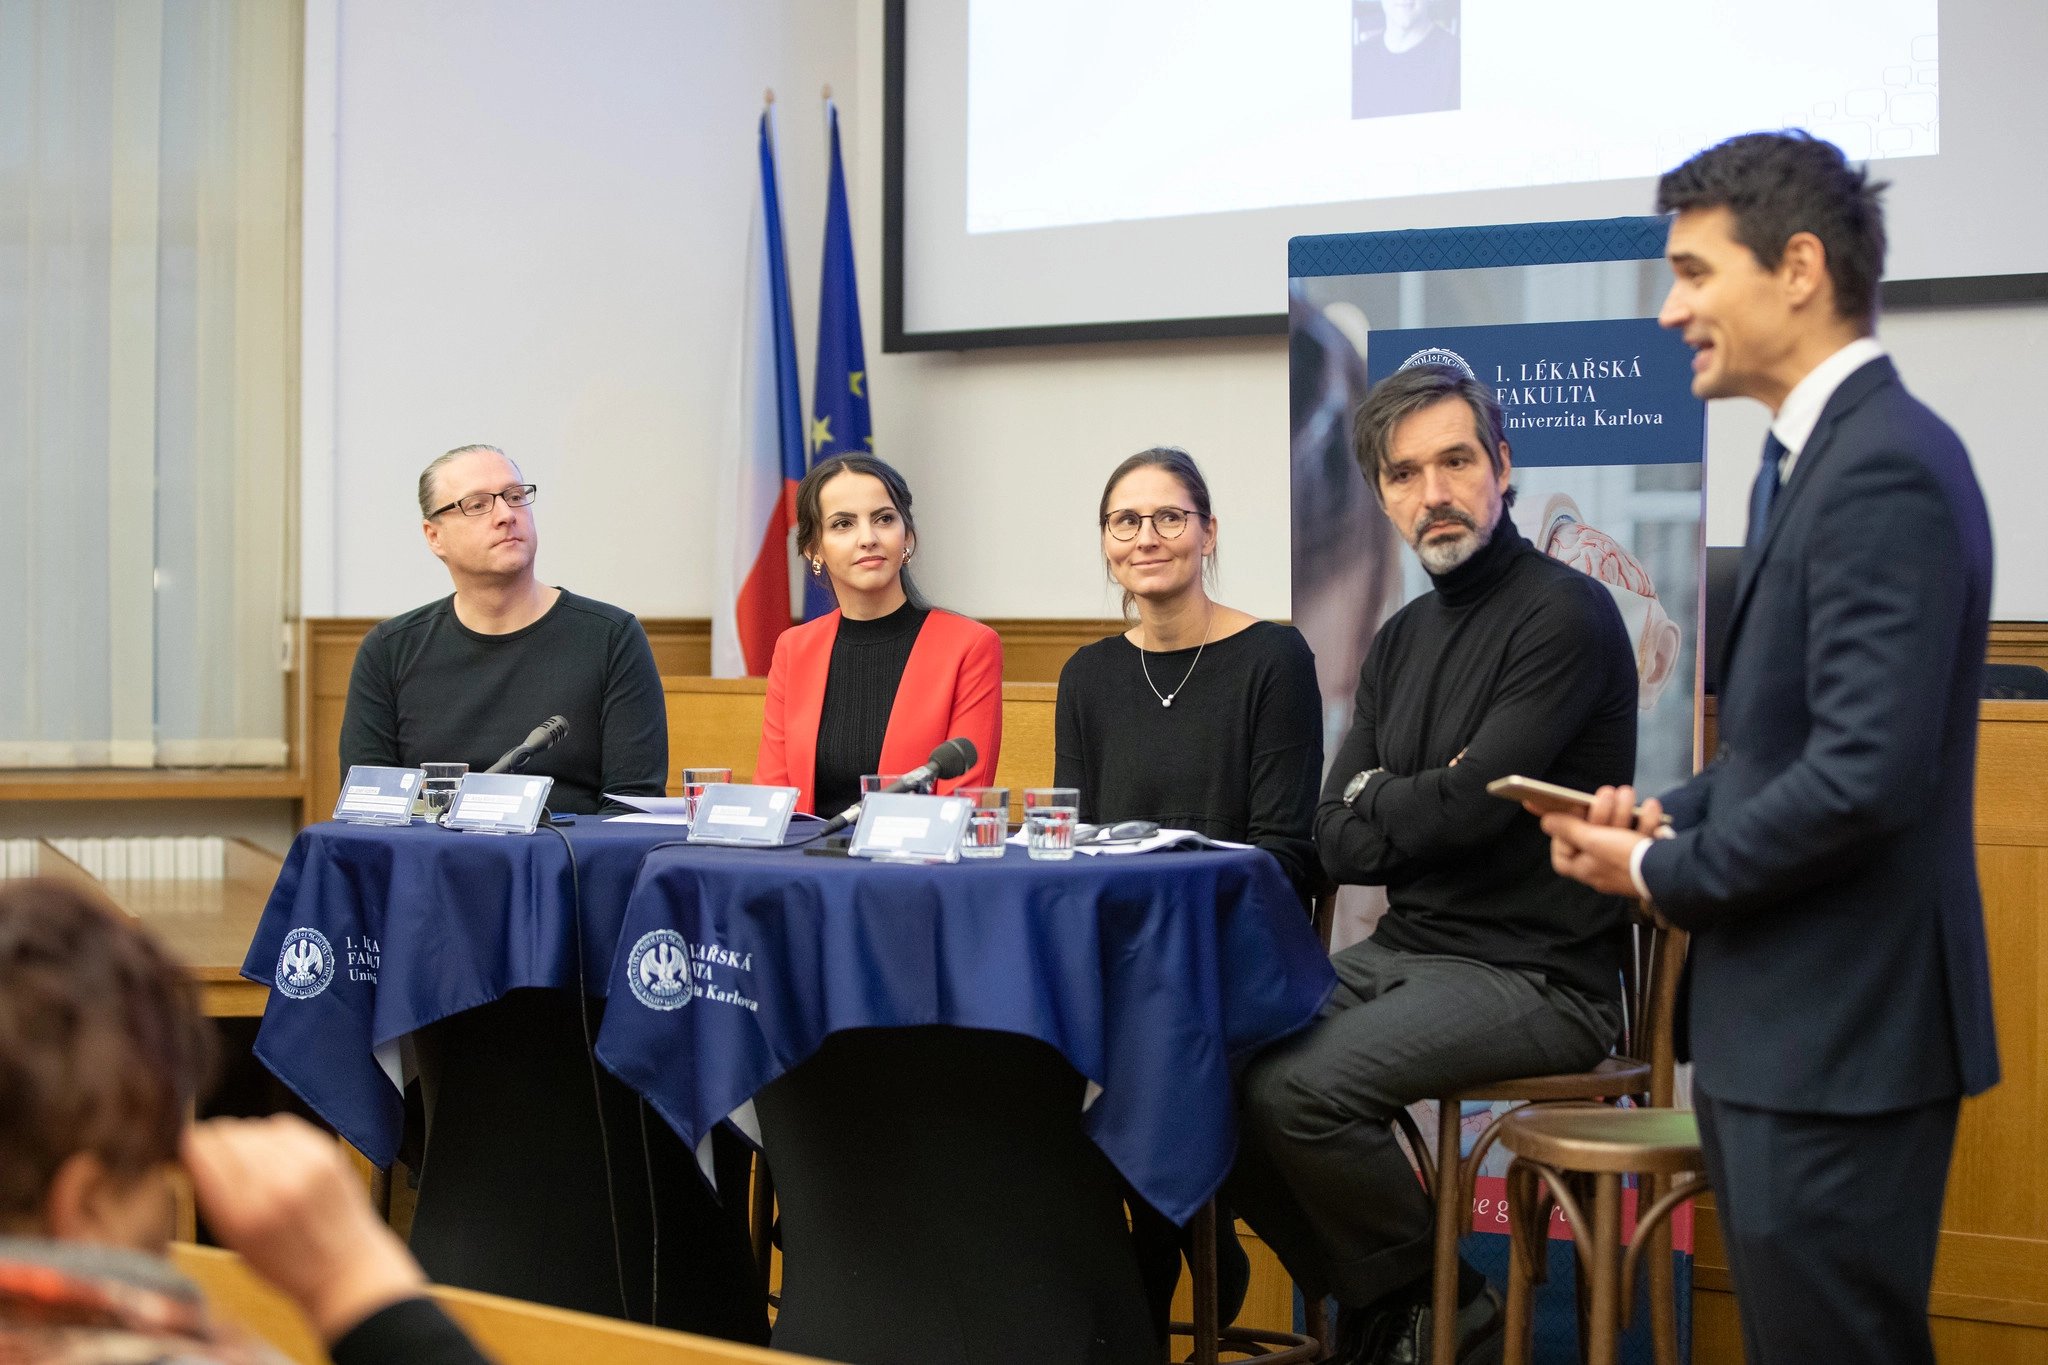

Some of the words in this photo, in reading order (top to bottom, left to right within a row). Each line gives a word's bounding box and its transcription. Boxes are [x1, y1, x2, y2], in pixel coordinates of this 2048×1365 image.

[1496, 365, 1510, 382] 1.
[1520, 355, 1642, 382] LÉKAŘSKÁ
[1496, 385, 1596, 406] FAKULTA
[1594, 408, 1663, 427] Karlova
[706, 983, 759, 1012] Karlova
